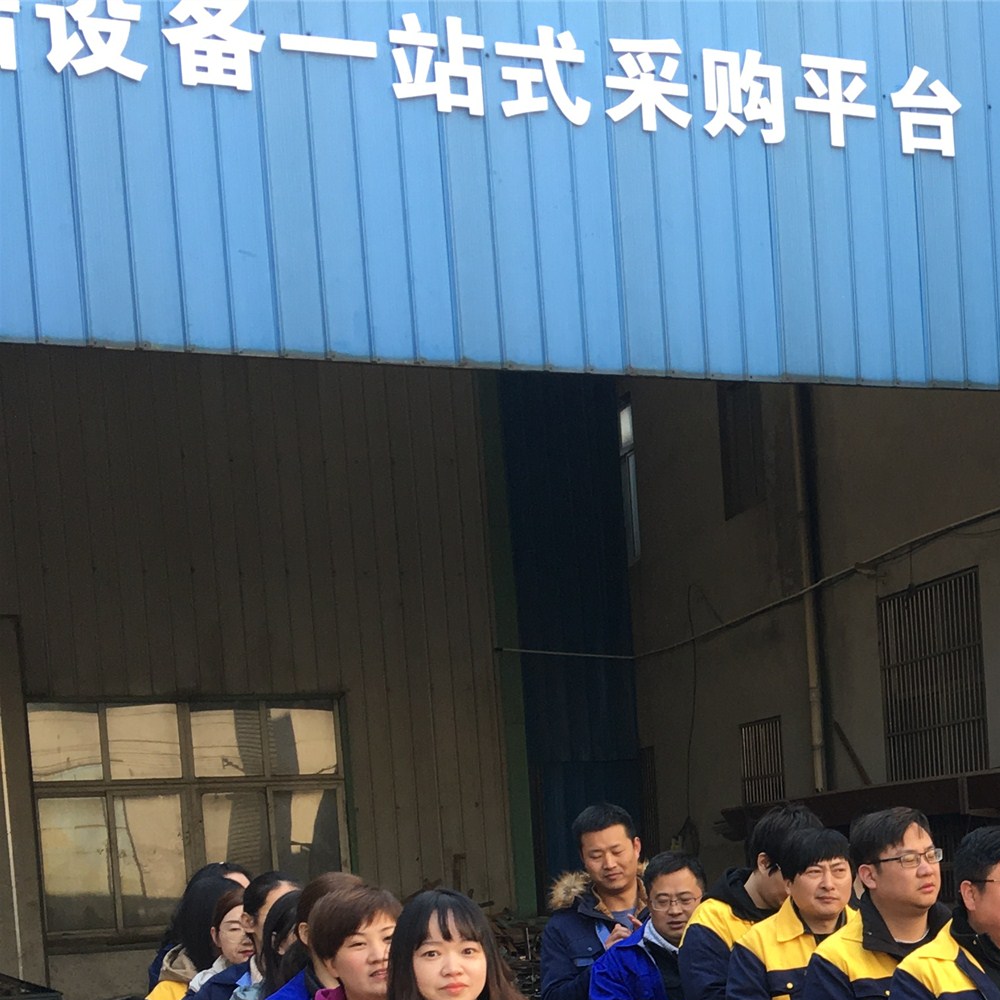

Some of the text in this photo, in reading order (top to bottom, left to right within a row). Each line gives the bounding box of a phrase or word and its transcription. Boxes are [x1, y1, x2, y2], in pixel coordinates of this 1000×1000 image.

[0, 0, 961, 157] 设备一站式采购平台
